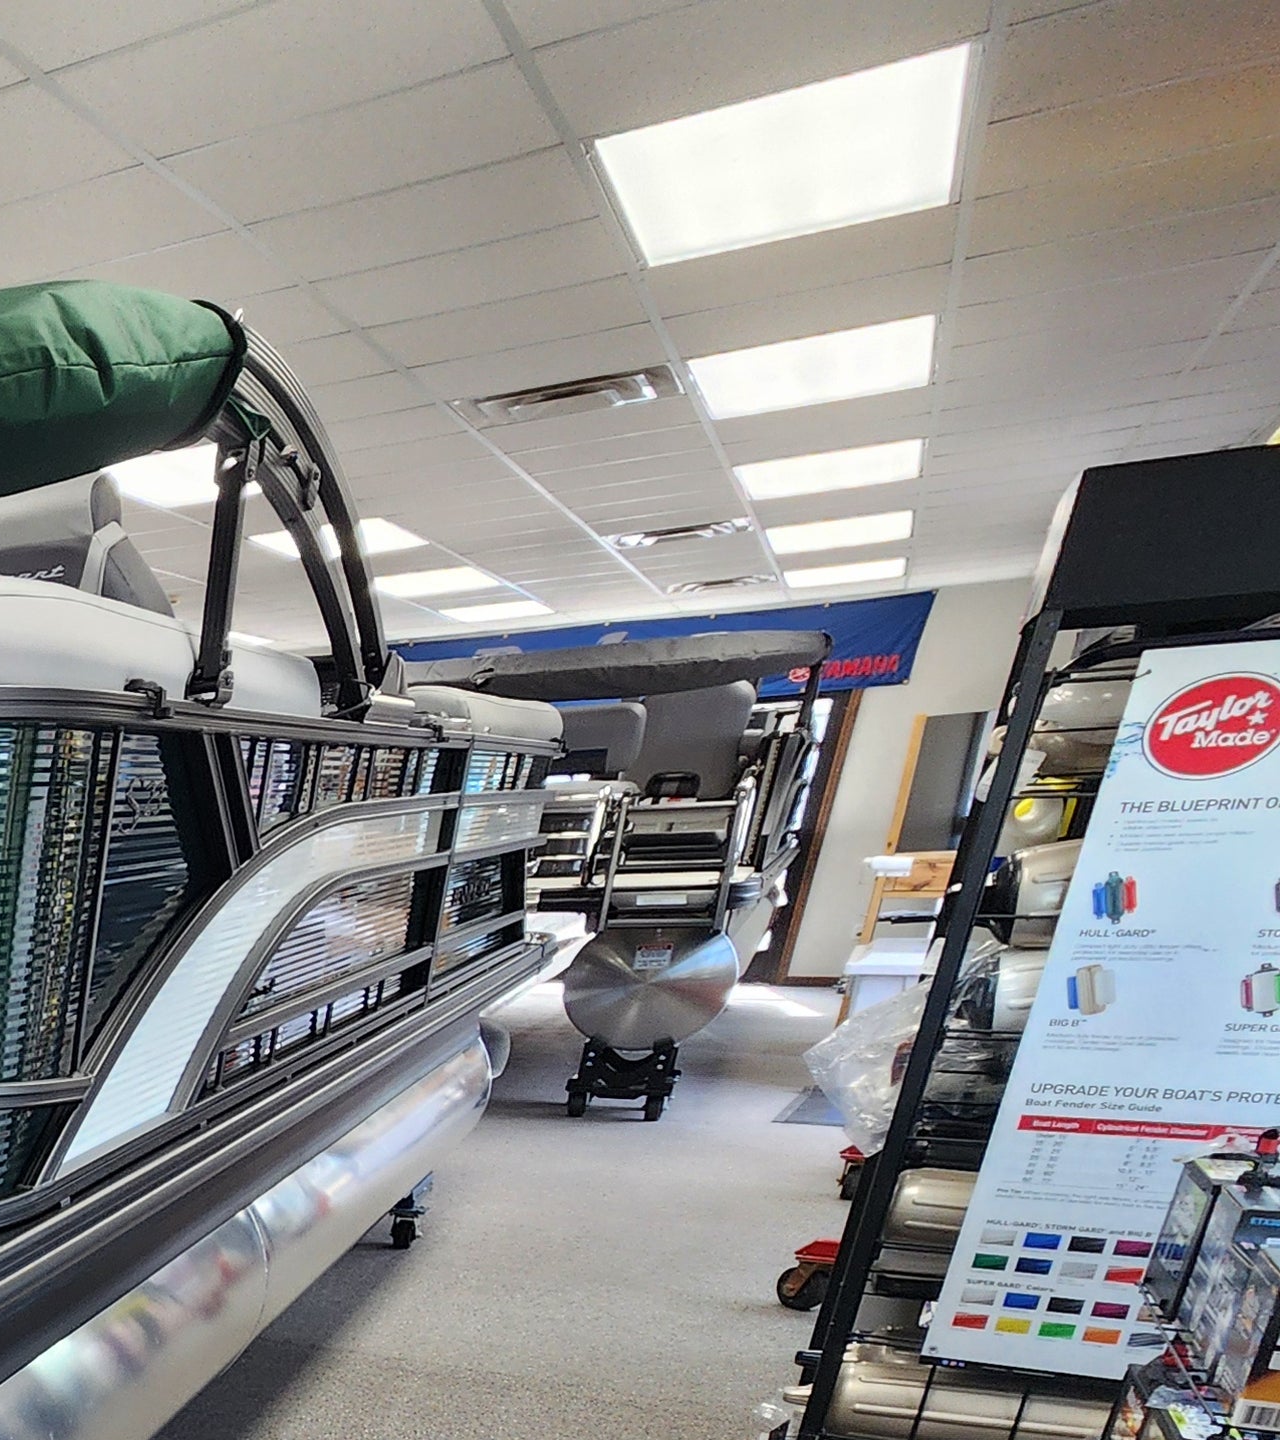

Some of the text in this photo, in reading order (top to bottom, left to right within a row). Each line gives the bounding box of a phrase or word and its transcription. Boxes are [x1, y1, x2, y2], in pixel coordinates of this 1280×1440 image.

[1158, 690, 1273, 741] Taylor
[1190, 728, 1271, 749] Made
[1120, 796, 1280, 814] THE BLUEPRINT O
[1049, 1018, 1070, 1028] BIG
[1224, 1022, 1280, 1033] SUPER G
[1030, 1082, 1110, 1098] UPGRADE
[1113, 1086, 1158, 1100] YOUR
[1162, 1089, 1222, 1102] BOAT'S
[1025, 1098, 1162, 1113] Boat Fender Size Guide
